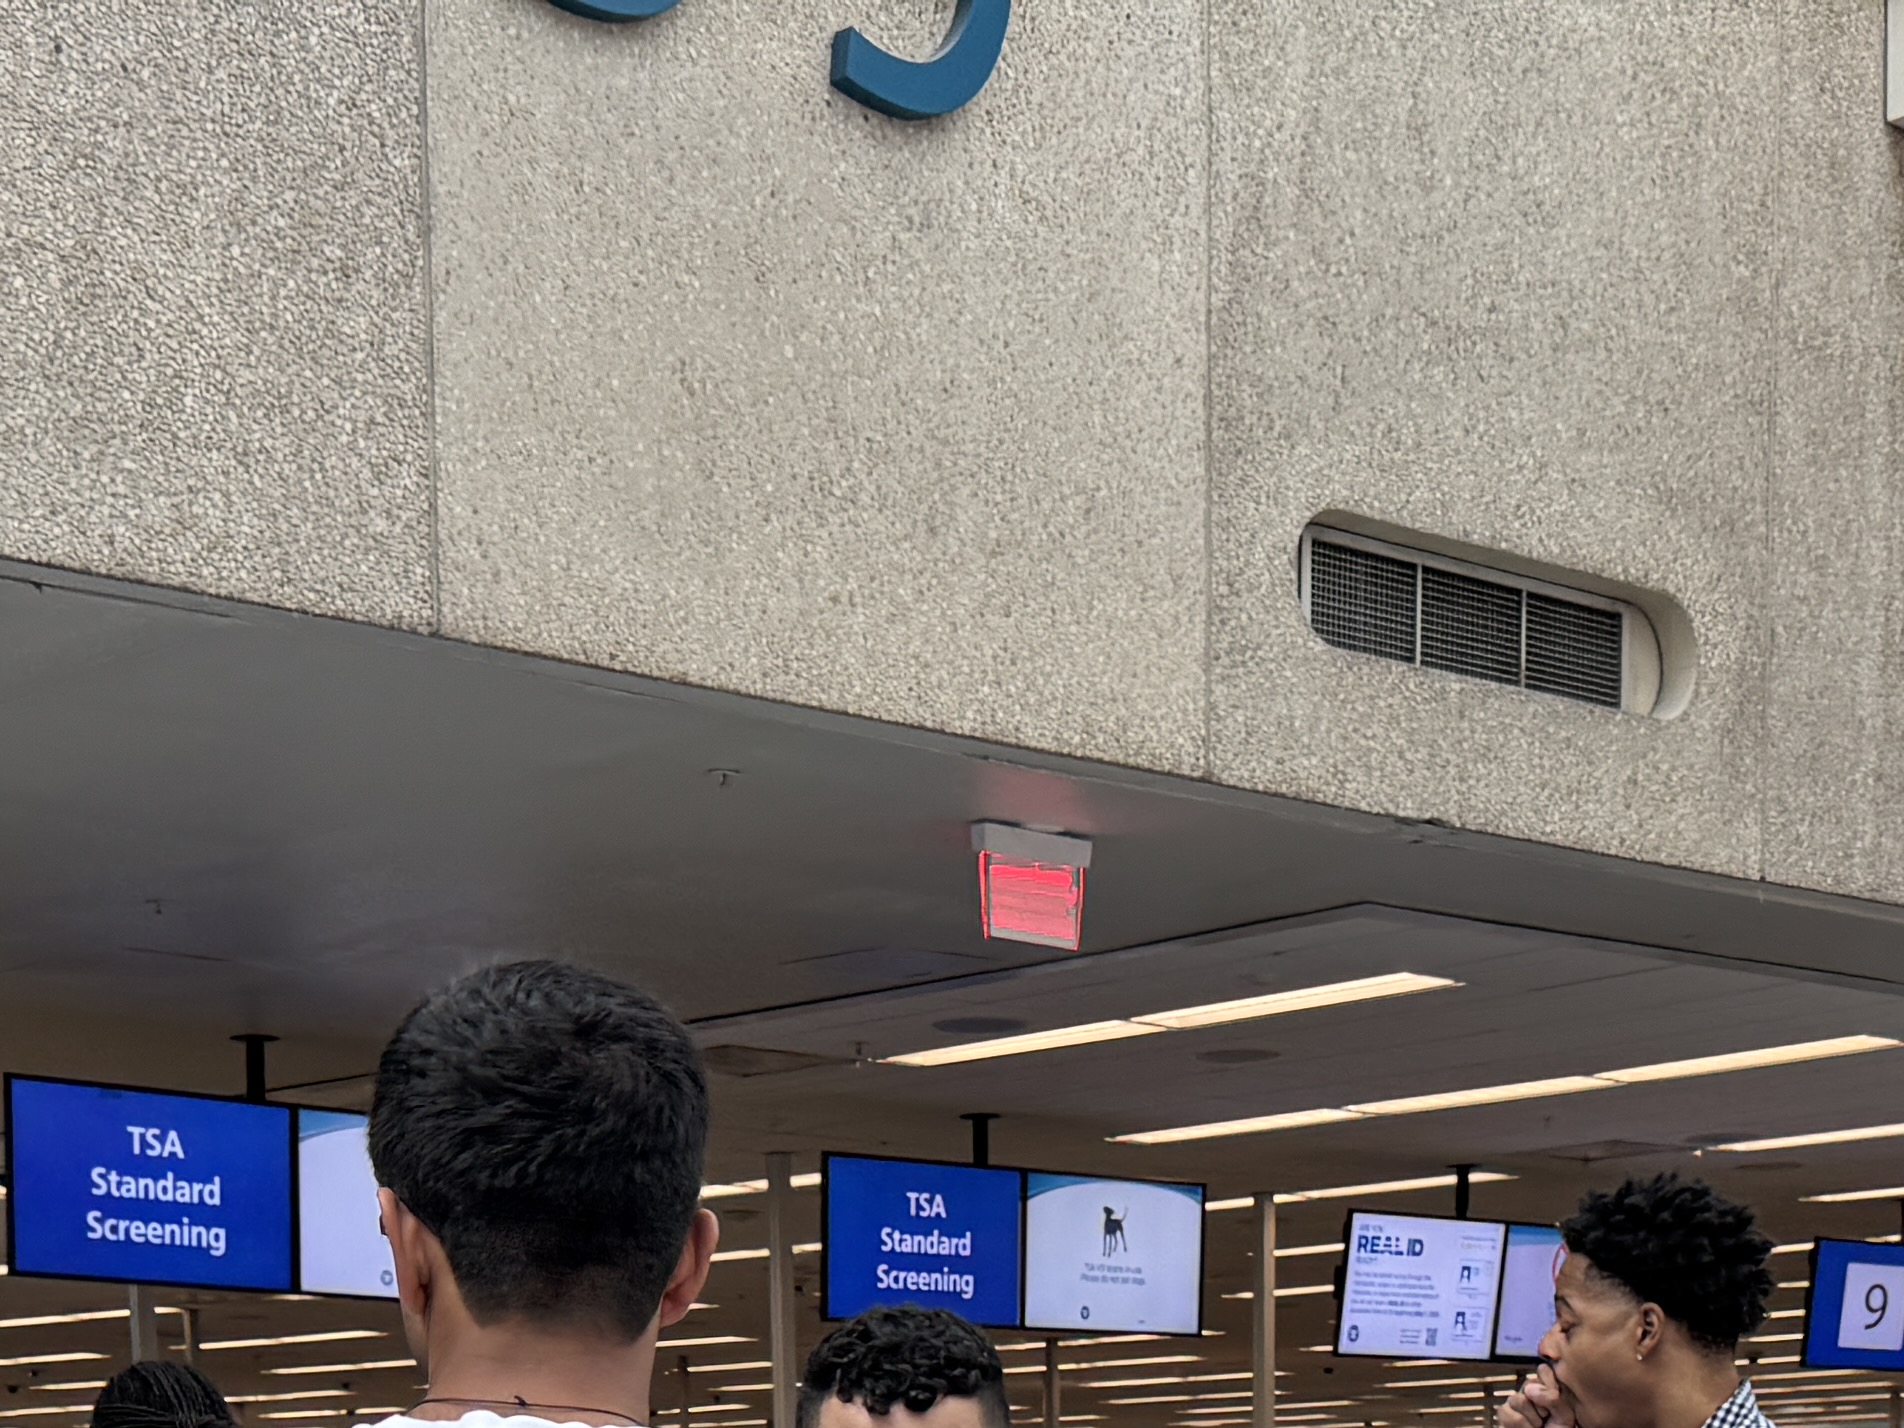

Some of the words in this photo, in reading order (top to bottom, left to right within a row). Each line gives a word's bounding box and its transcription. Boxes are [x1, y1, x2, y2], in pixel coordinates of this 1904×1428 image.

[126, 1125, 185, 1160] TSA
[90, 1166, 221, 1206] Standard
[906, 1191, 947, 1219] TSA
[86, 1210, 226, 1257] Screening
[880, 1226, 972, 1257] Standard
[1357, 1235, 1404, 1257] REAL
[1406, 1238, 1425, 1257] ID
[876, 1263, 974, 1300] Screening
[1864, 1283, 1888, 1330] 9
